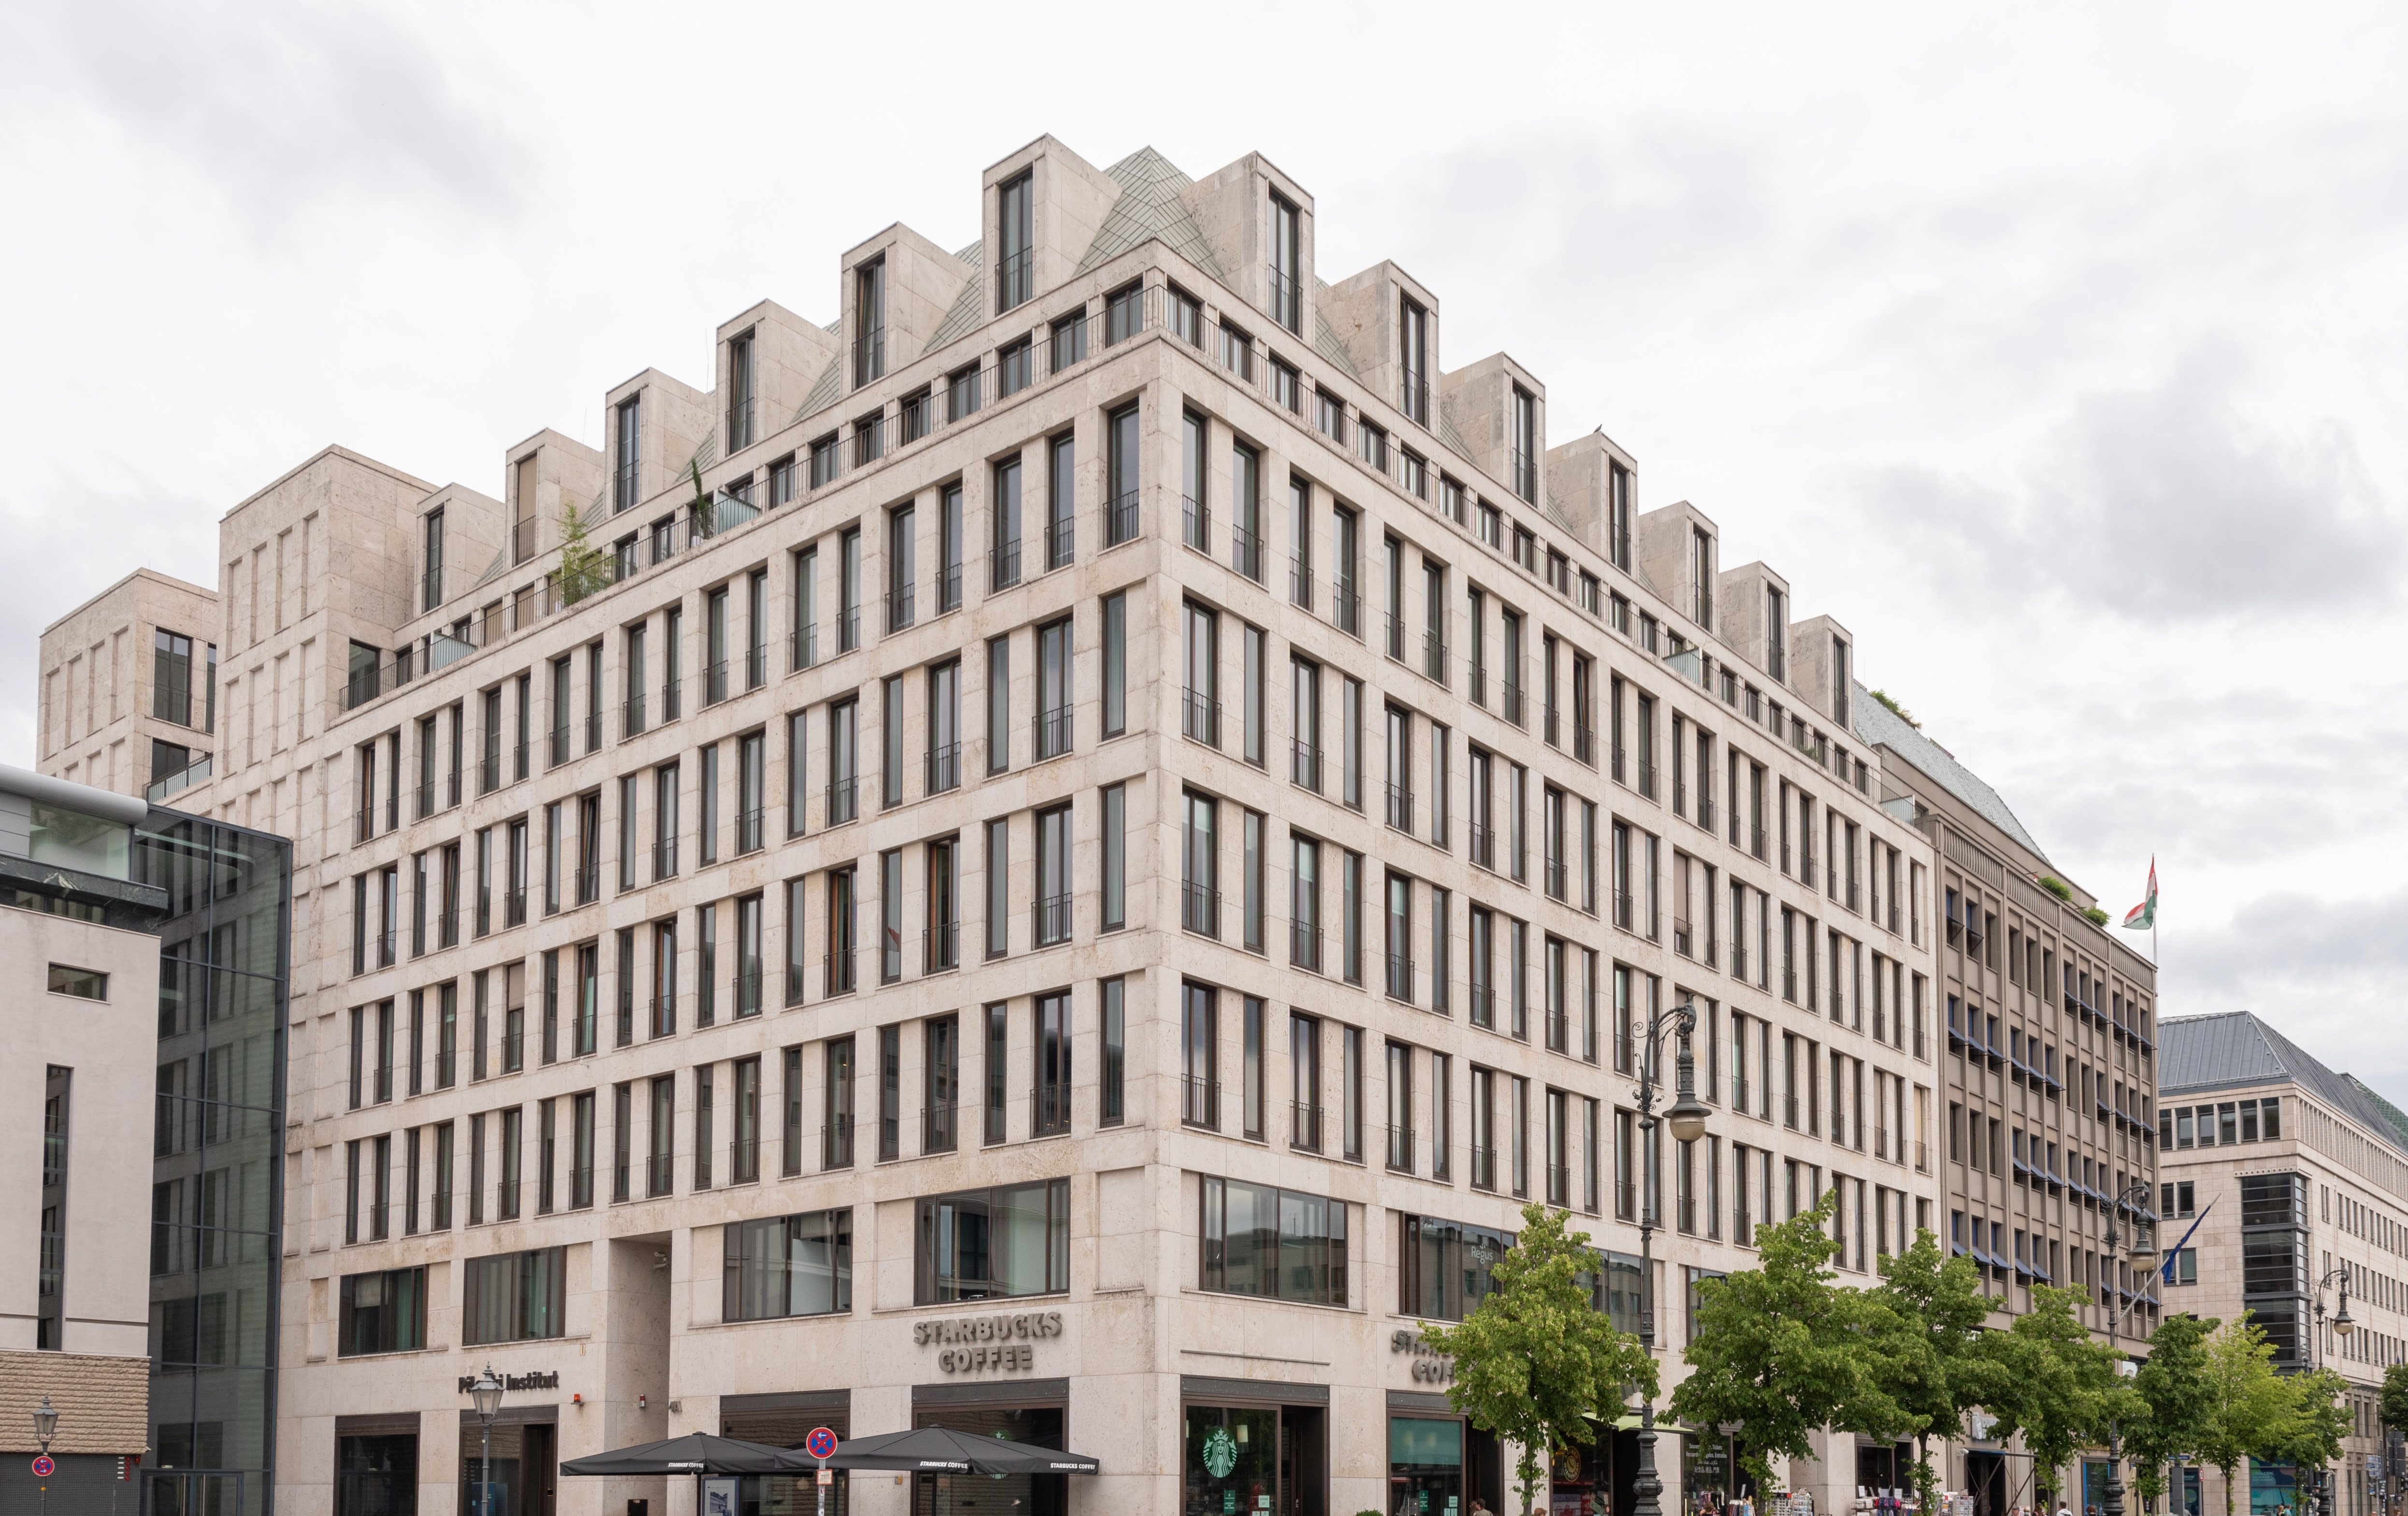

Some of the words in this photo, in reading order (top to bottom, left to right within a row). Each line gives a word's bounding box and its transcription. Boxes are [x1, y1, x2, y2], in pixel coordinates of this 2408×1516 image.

[913, 1312, 1062, 1344] STARBUCKS
[938, 1344, 1033, 1373] COFFEE
[1412, 1359, 1455, 1382] COF
[458, 1374, 503, 1394] Pili
[506, 1371, 559, 1391] Institut
